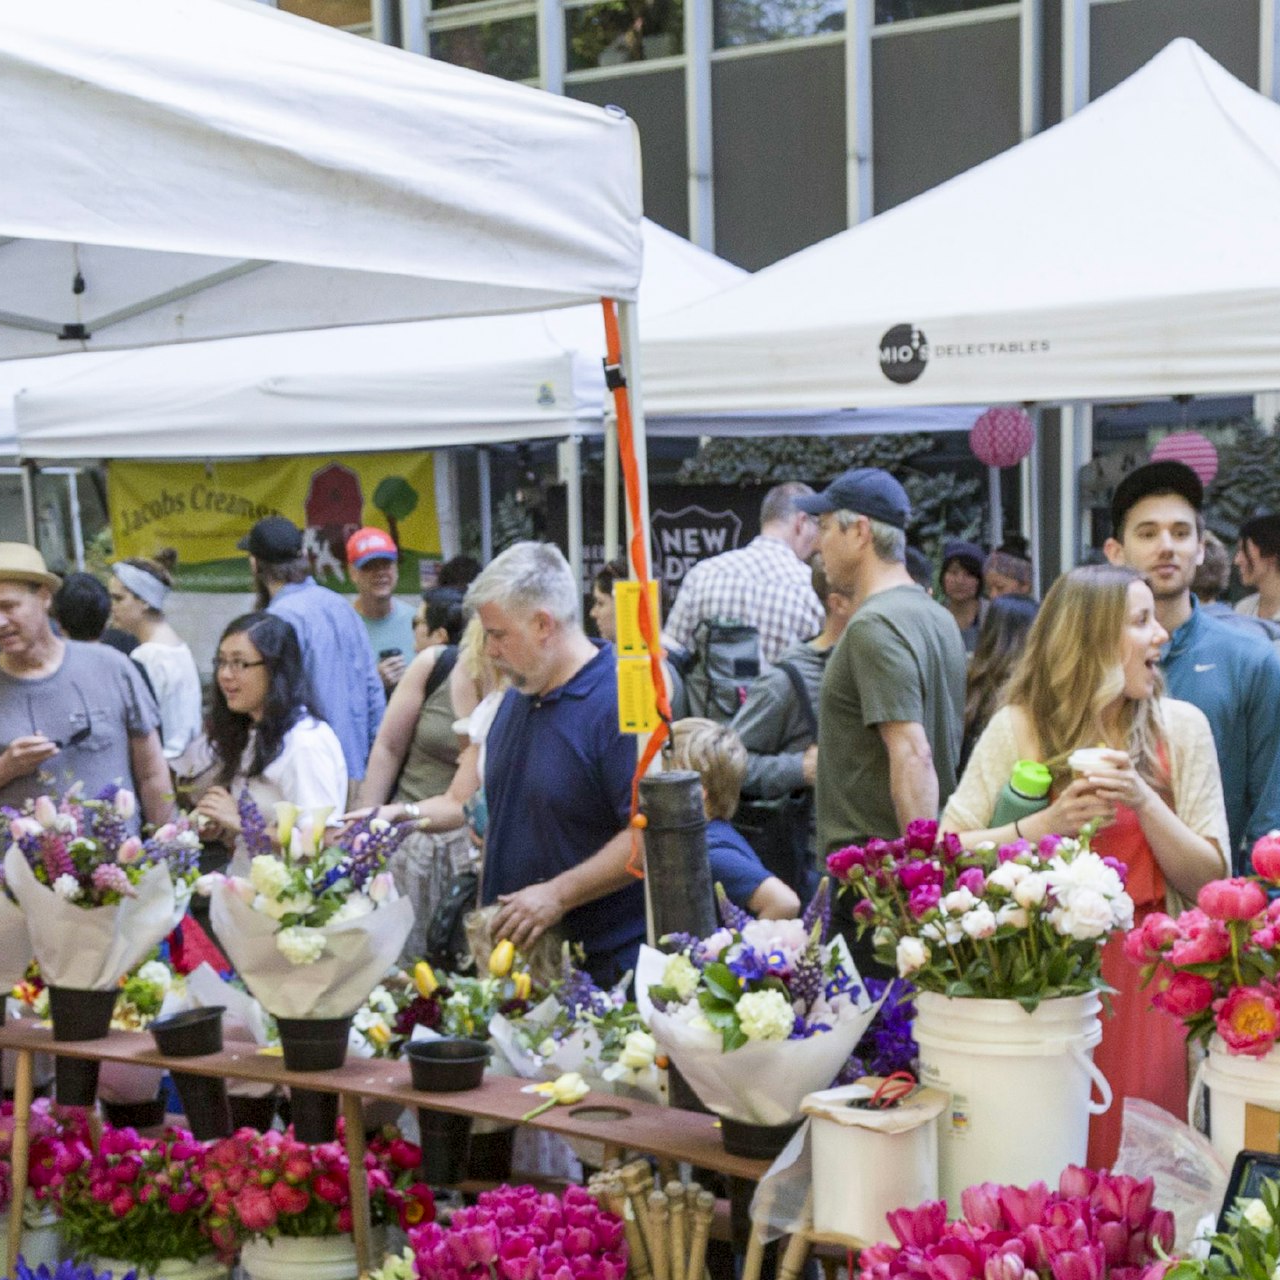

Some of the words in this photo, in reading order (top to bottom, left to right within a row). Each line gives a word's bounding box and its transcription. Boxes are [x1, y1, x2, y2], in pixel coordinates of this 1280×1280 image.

[880, 343, 929, 364] MIO'S
[935, 339, 1051, 359] DELECTABLES
[121, 489, 186, 537] Jacobs
[661, 528, 727, 554] NEW
